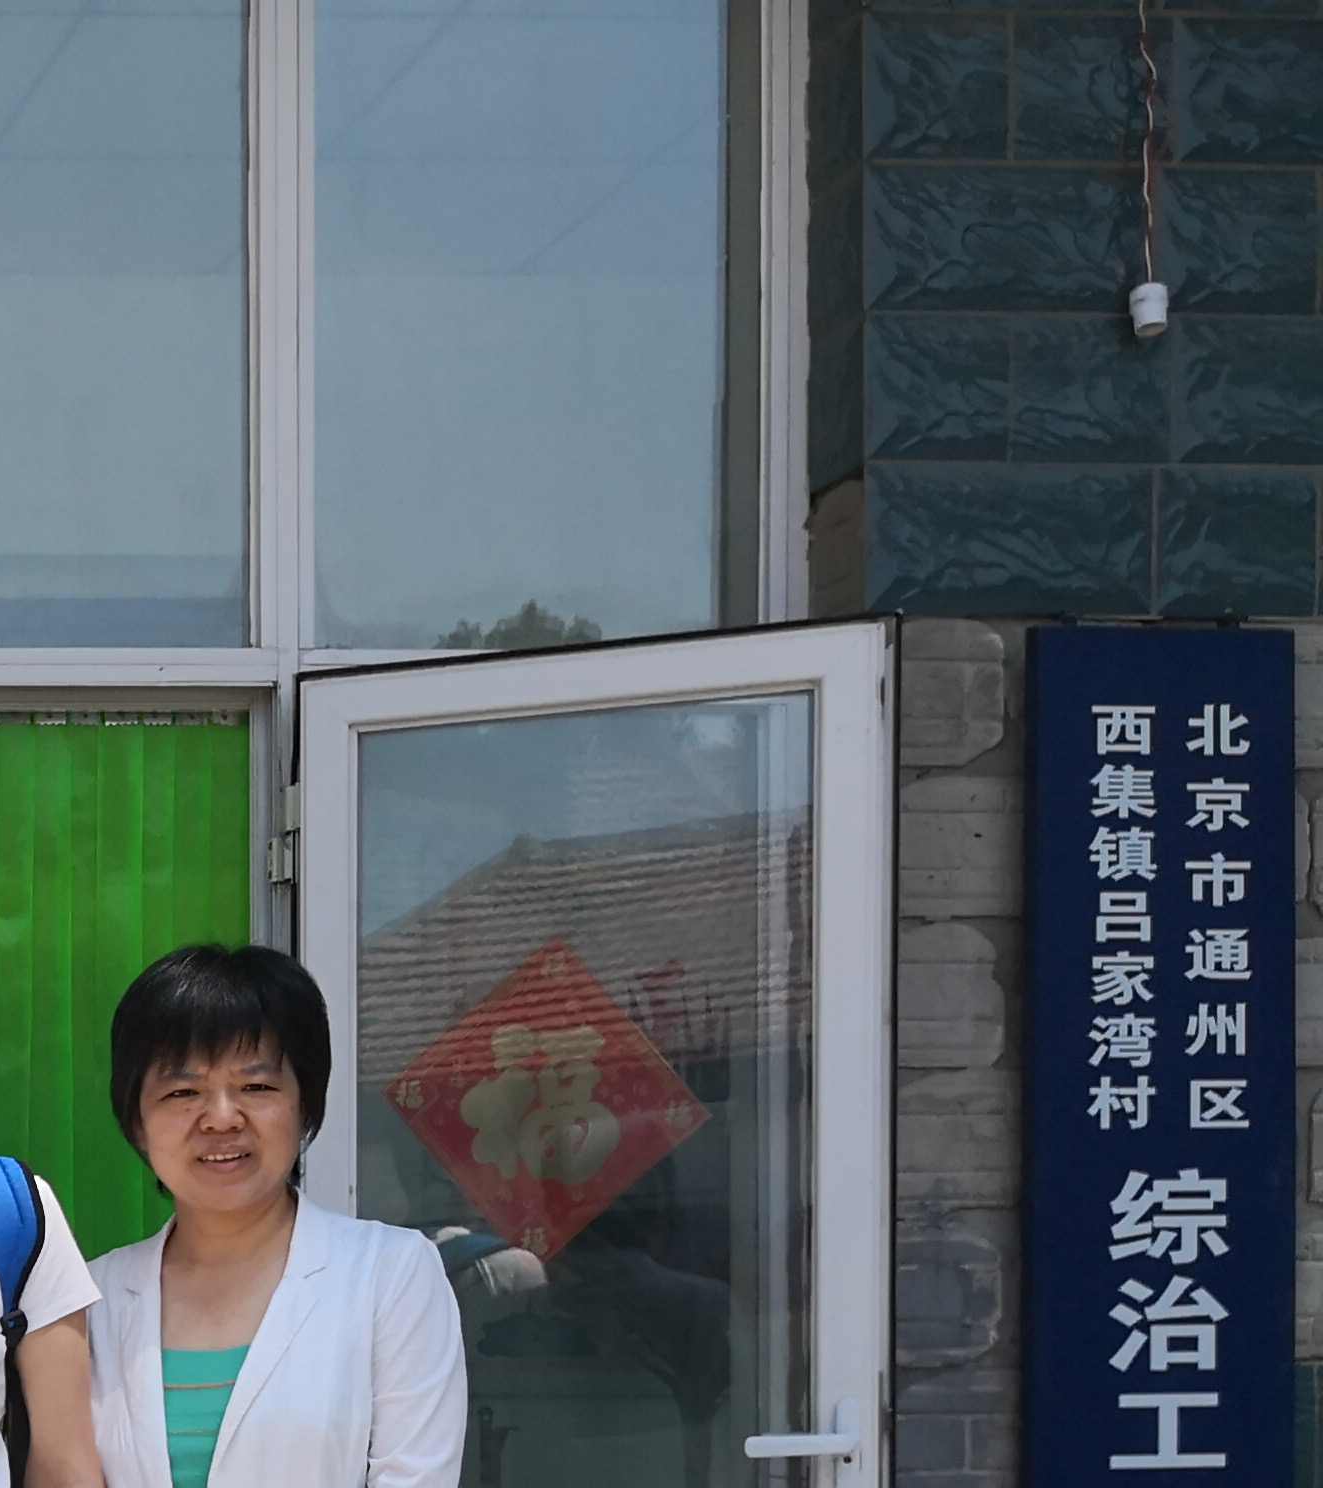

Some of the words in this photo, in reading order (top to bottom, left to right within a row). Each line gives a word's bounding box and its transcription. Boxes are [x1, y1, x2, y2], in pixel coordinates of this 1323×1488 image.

[1087, 704, 1157, 1130] 西集镇吕家湾村
[1184, 703, 1252, 1129] 北京市通州区
